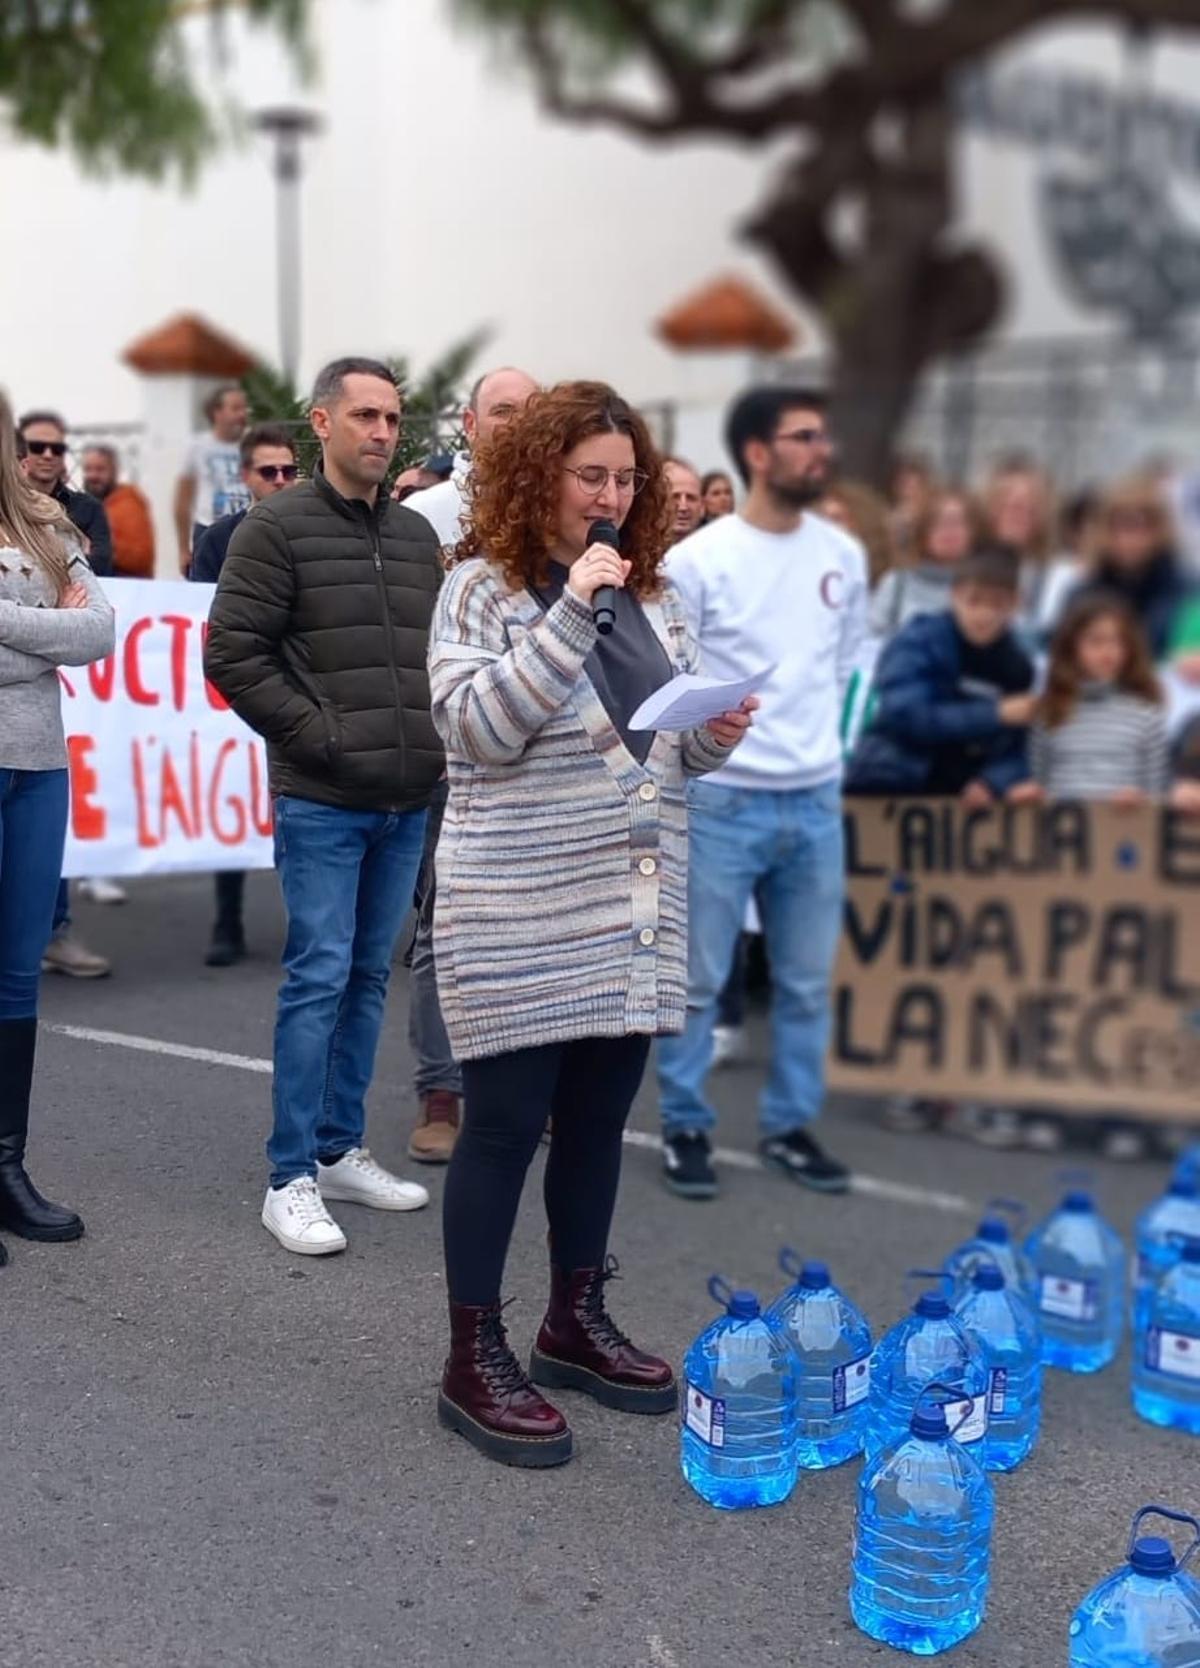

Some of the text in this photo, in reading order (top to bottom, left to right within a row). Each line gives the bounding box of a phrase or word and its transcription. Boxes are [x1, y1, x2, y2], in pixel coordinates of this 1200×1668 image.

[819, 570, 844, 610] C
[844, 800, 1091, 876] L'AIGUA
[843, 877, 1025, 980] VIDA
[834, 984, 944, 1072] LA
